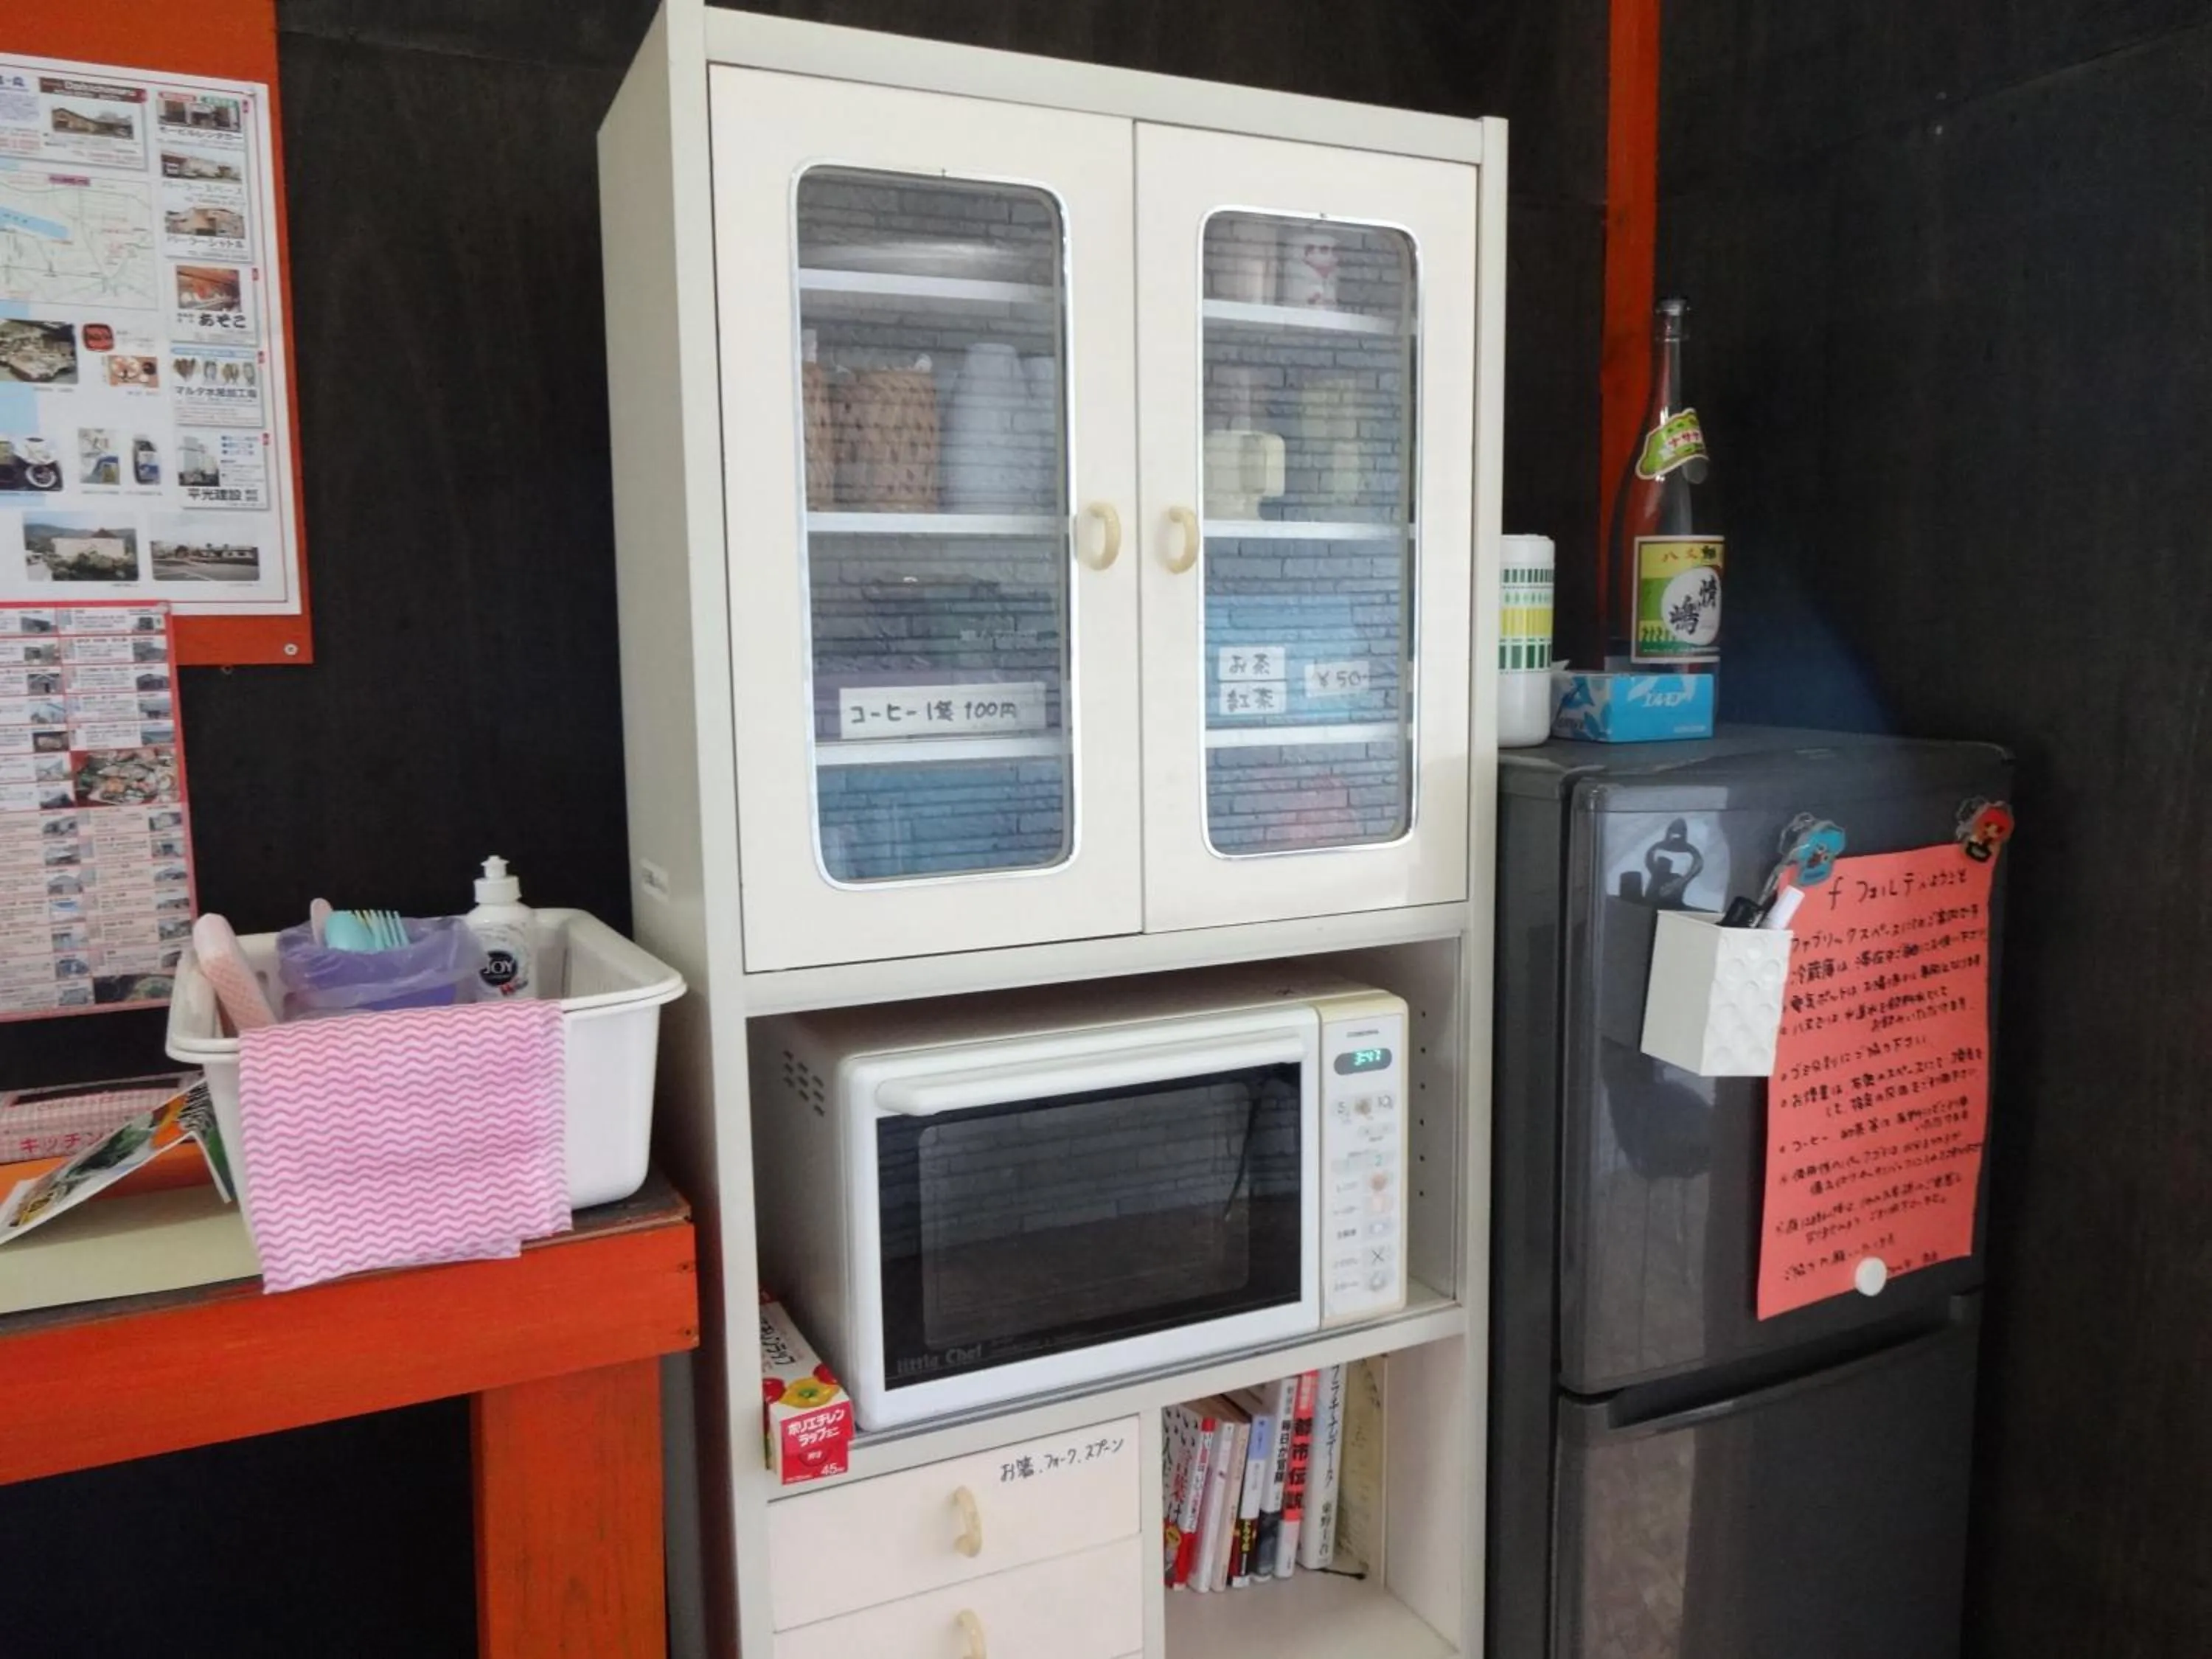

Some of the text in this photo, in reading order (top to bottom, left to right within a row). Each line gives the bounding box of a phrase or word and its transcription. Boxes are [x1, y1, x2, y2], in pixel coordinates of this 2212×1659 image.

[198, 312, 246, 329] あそこ
[1227, 686, 1274, 712] 紅茶
[482, 958, 514, 974] JOY
[787, 1408, 846, 1436] ポリエチレン
